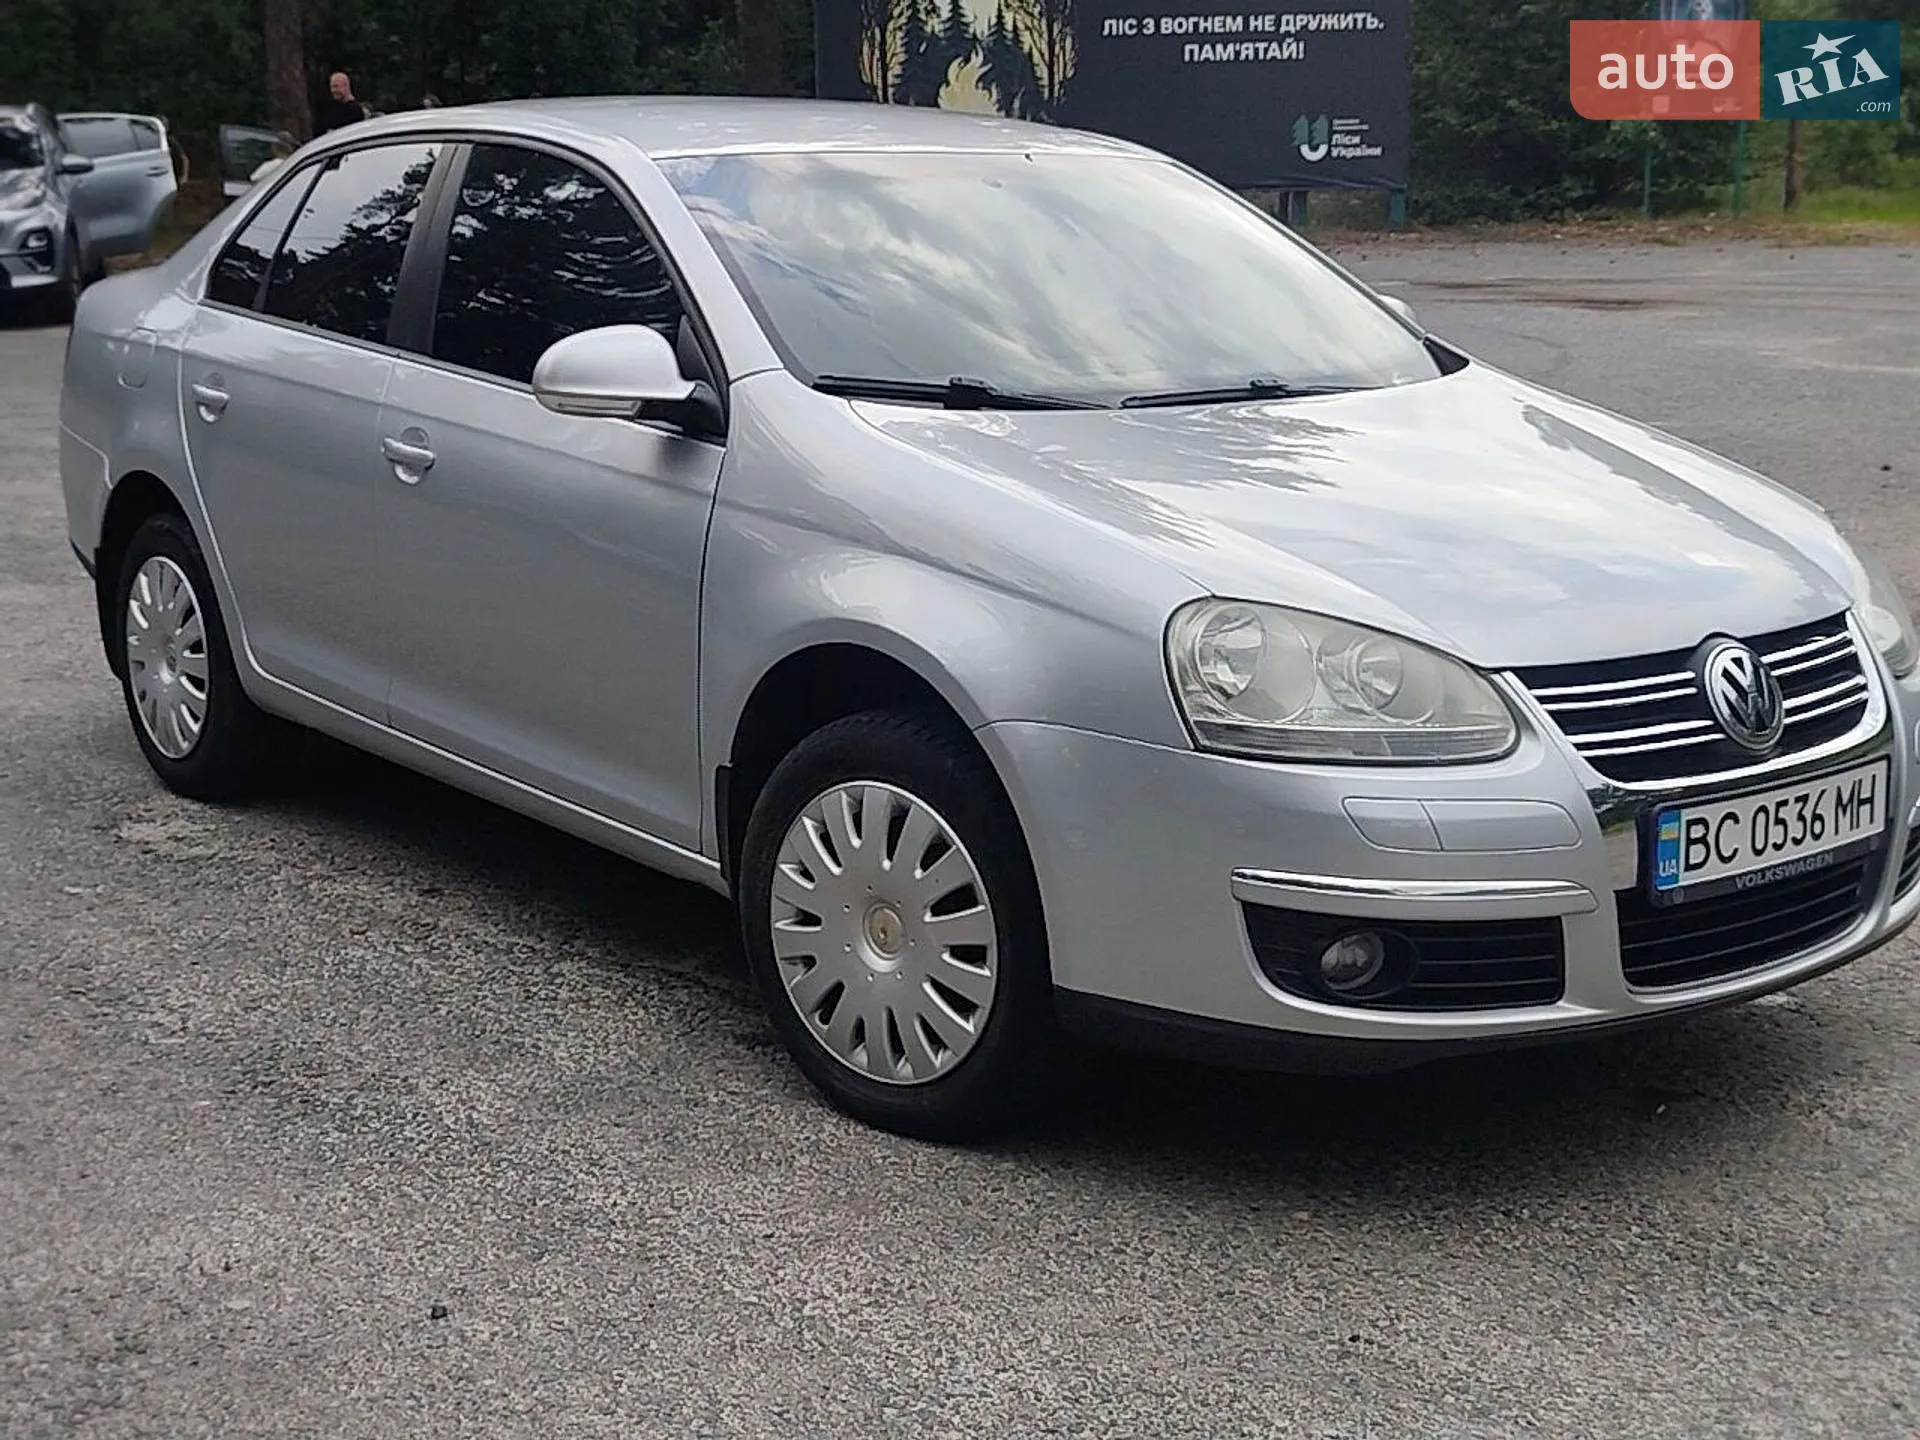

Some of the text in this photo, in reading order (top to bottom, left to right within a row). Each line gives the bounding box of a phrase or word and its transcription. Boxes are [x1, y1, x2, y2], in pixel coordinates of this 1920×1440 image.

[1102, 18, 1138, 36] ЛІС
[1160, 15, 1243, 35] ВОГНЕМ
[1250, 15, 1276, 33] НЕ
[1279, 11, 1385, 34] ДРУЖИТЬ.
[1683, 773, 1877, 873] BC 0536 MH
[1658, 859, 1677, 878] UA
[1735, 851, 1834, 889] VOLKSWAGEN
